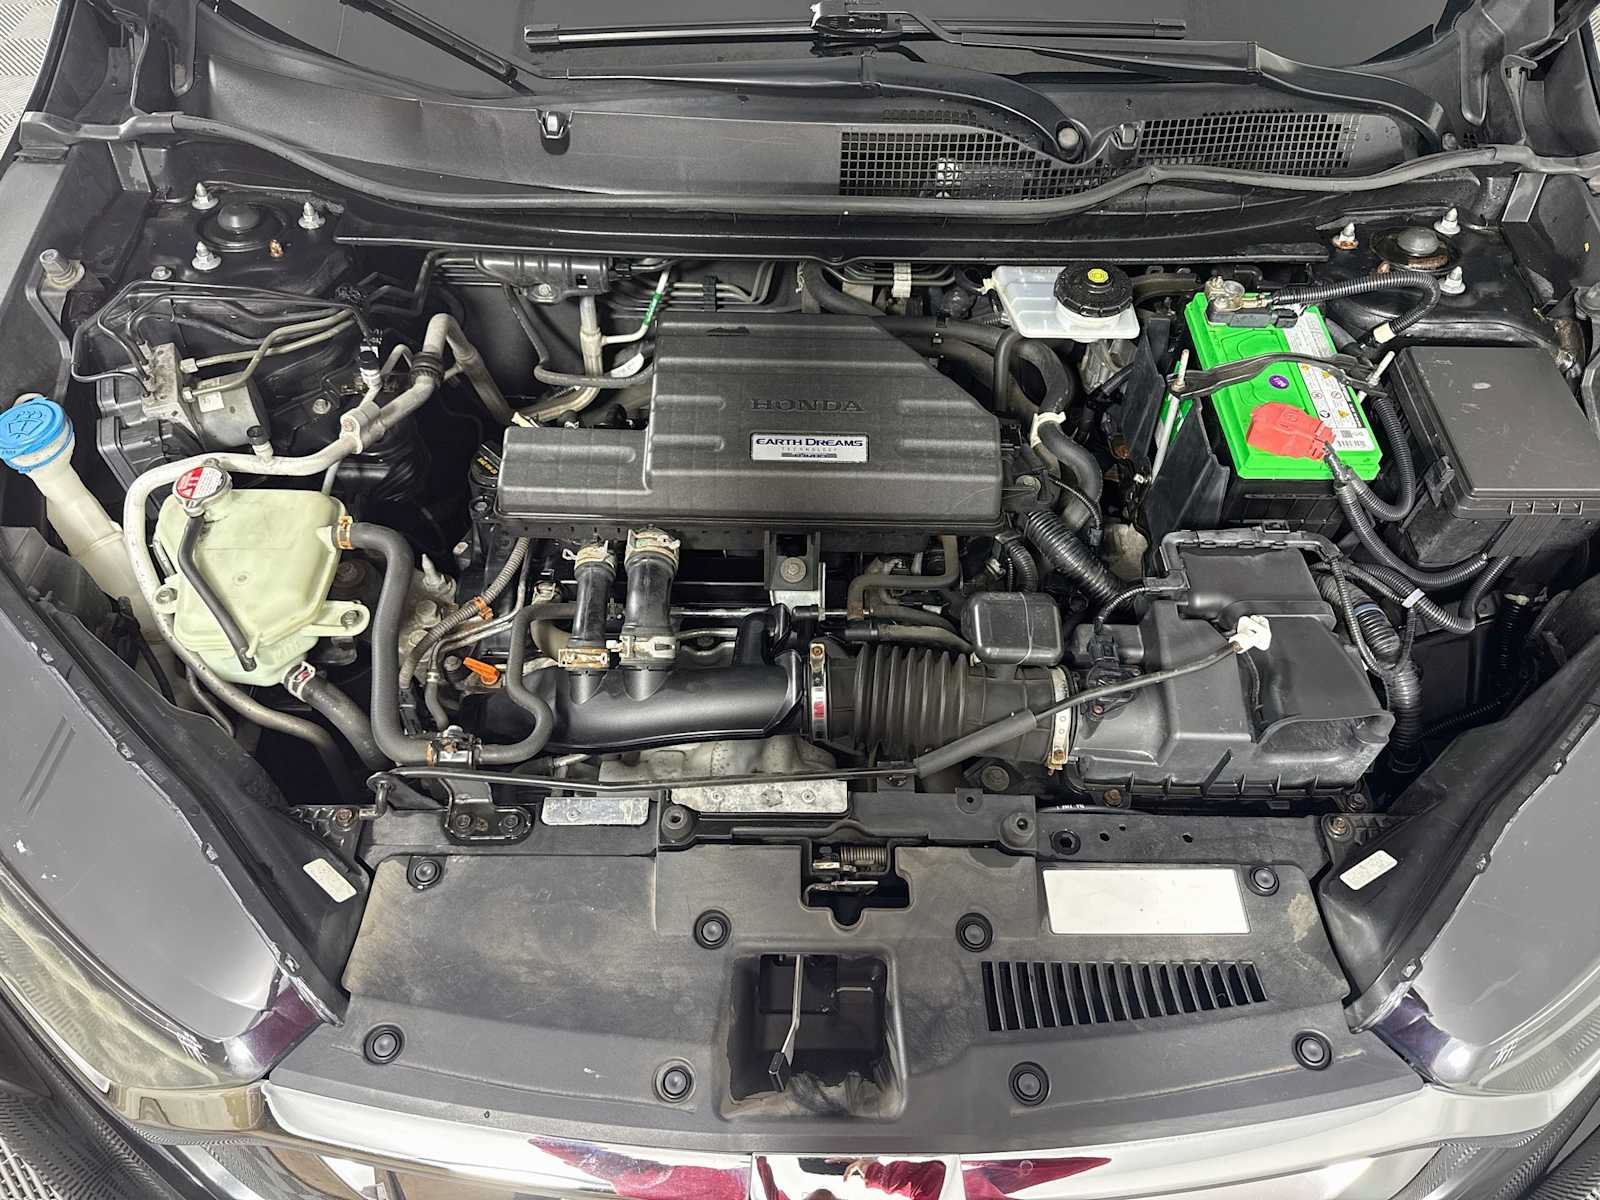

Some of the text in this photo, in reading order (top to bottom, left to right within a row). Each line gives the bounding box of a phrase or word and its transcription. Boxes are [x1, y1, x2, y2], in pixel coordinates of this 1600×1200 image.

[751, 399, 865, 413] HONDA
[756, 438, 863, 447] EARTH DREAMS
